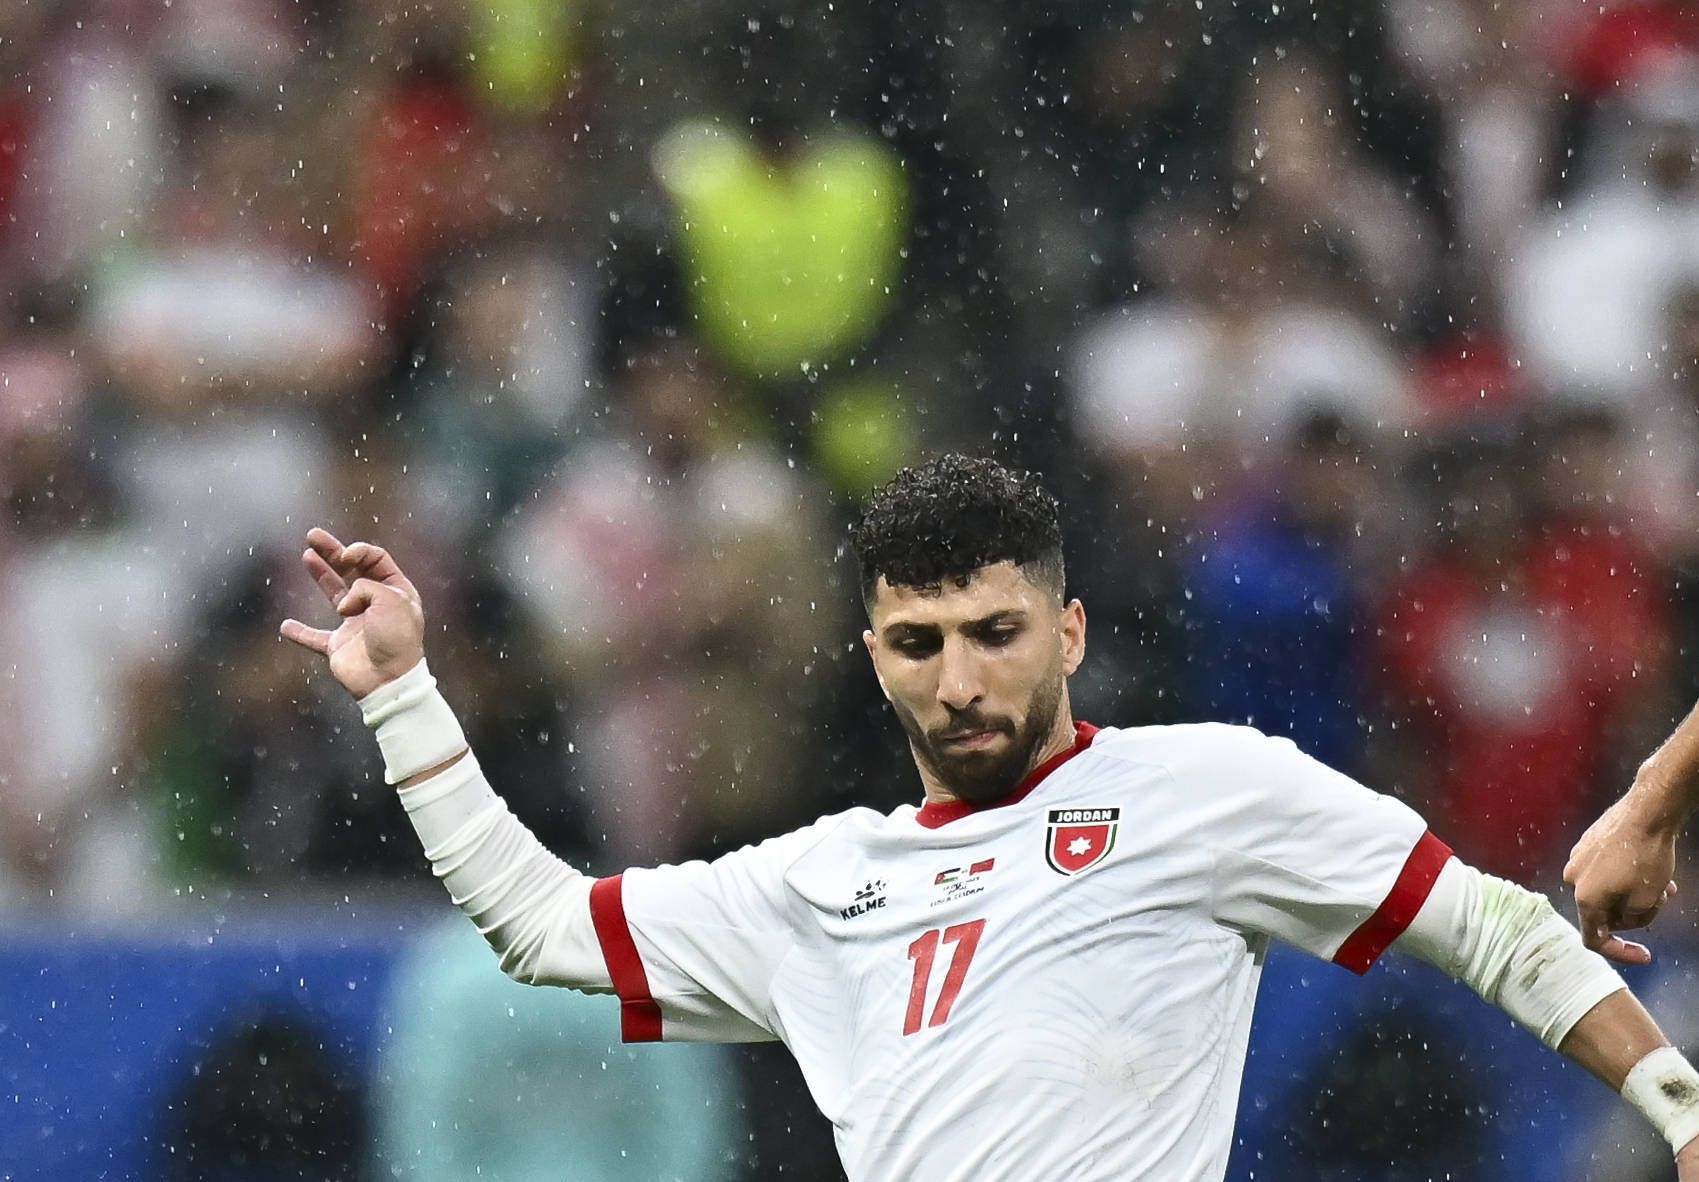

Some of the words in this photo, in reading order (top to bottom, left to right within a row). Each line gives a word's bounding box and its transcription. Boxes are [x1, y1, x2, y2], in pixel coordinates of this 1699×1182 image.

[1056, 809, 1112, 823] JORDAN
[840, 896, 887, 921] KELME
[902, 917, 987, 1037] 17
